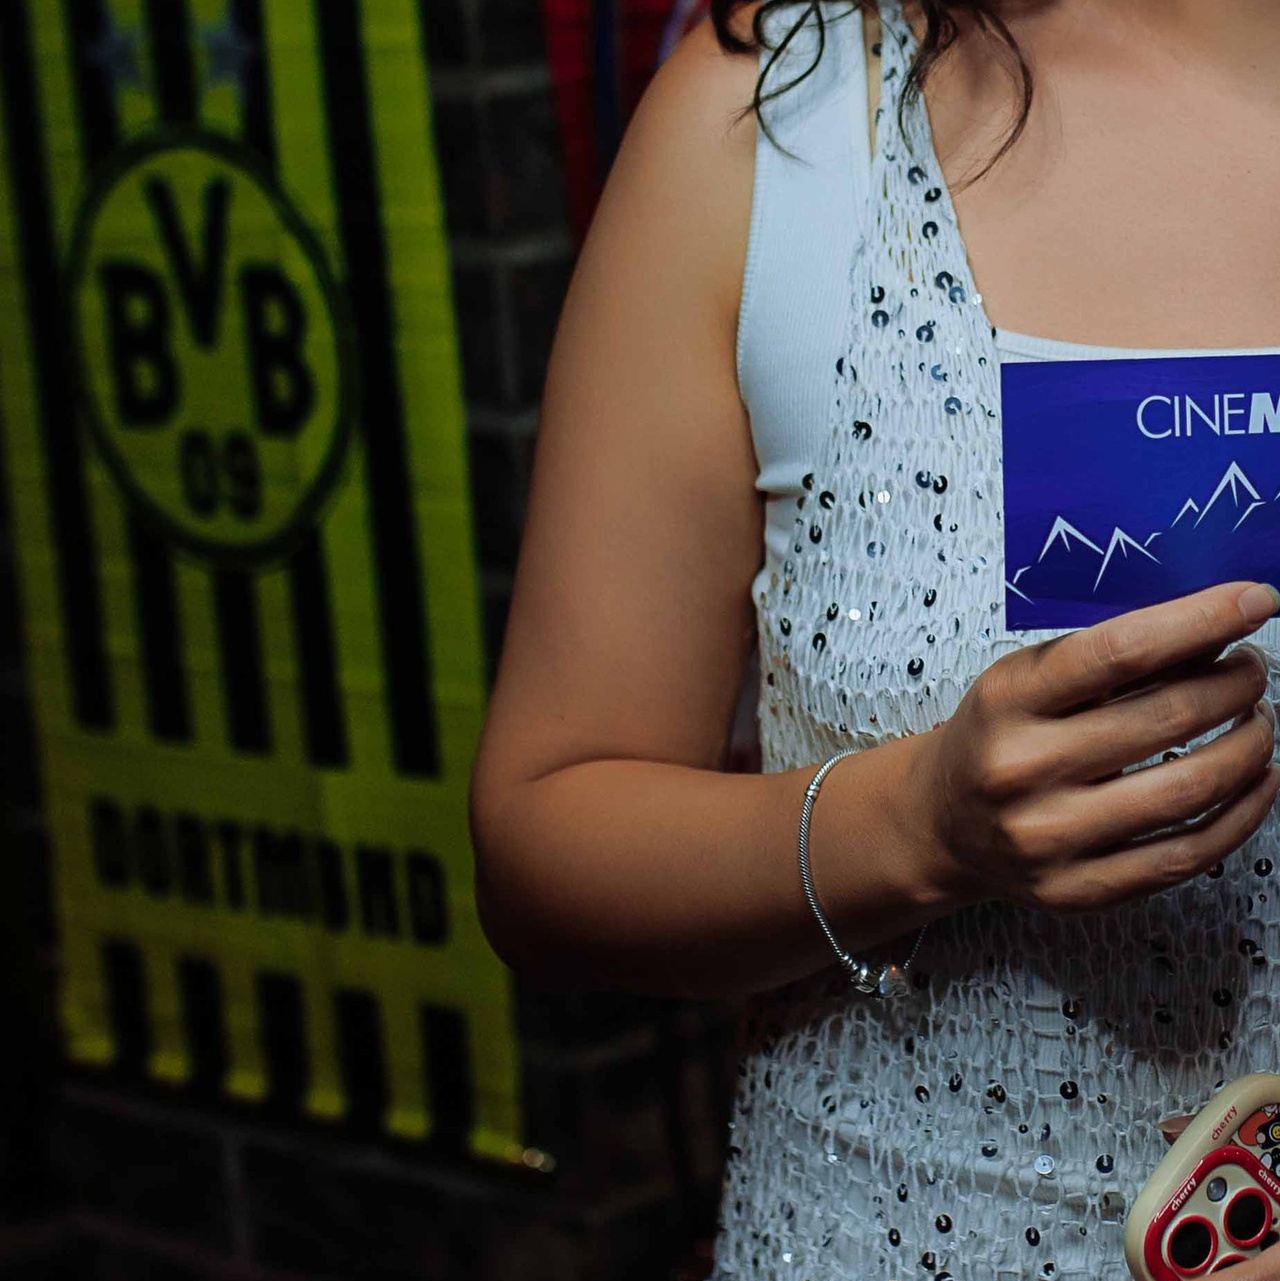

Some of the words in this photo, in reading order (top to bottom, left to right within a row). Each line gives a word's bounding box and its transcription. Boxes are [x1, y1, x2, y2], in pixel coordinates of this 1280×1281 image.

[100, 175, 312, 435] BVB
[182, 430, 260, 516] 09
[1211, 1106, 1238, 1141] cherry
[1171, 1177, 1198, 1213] cherry
